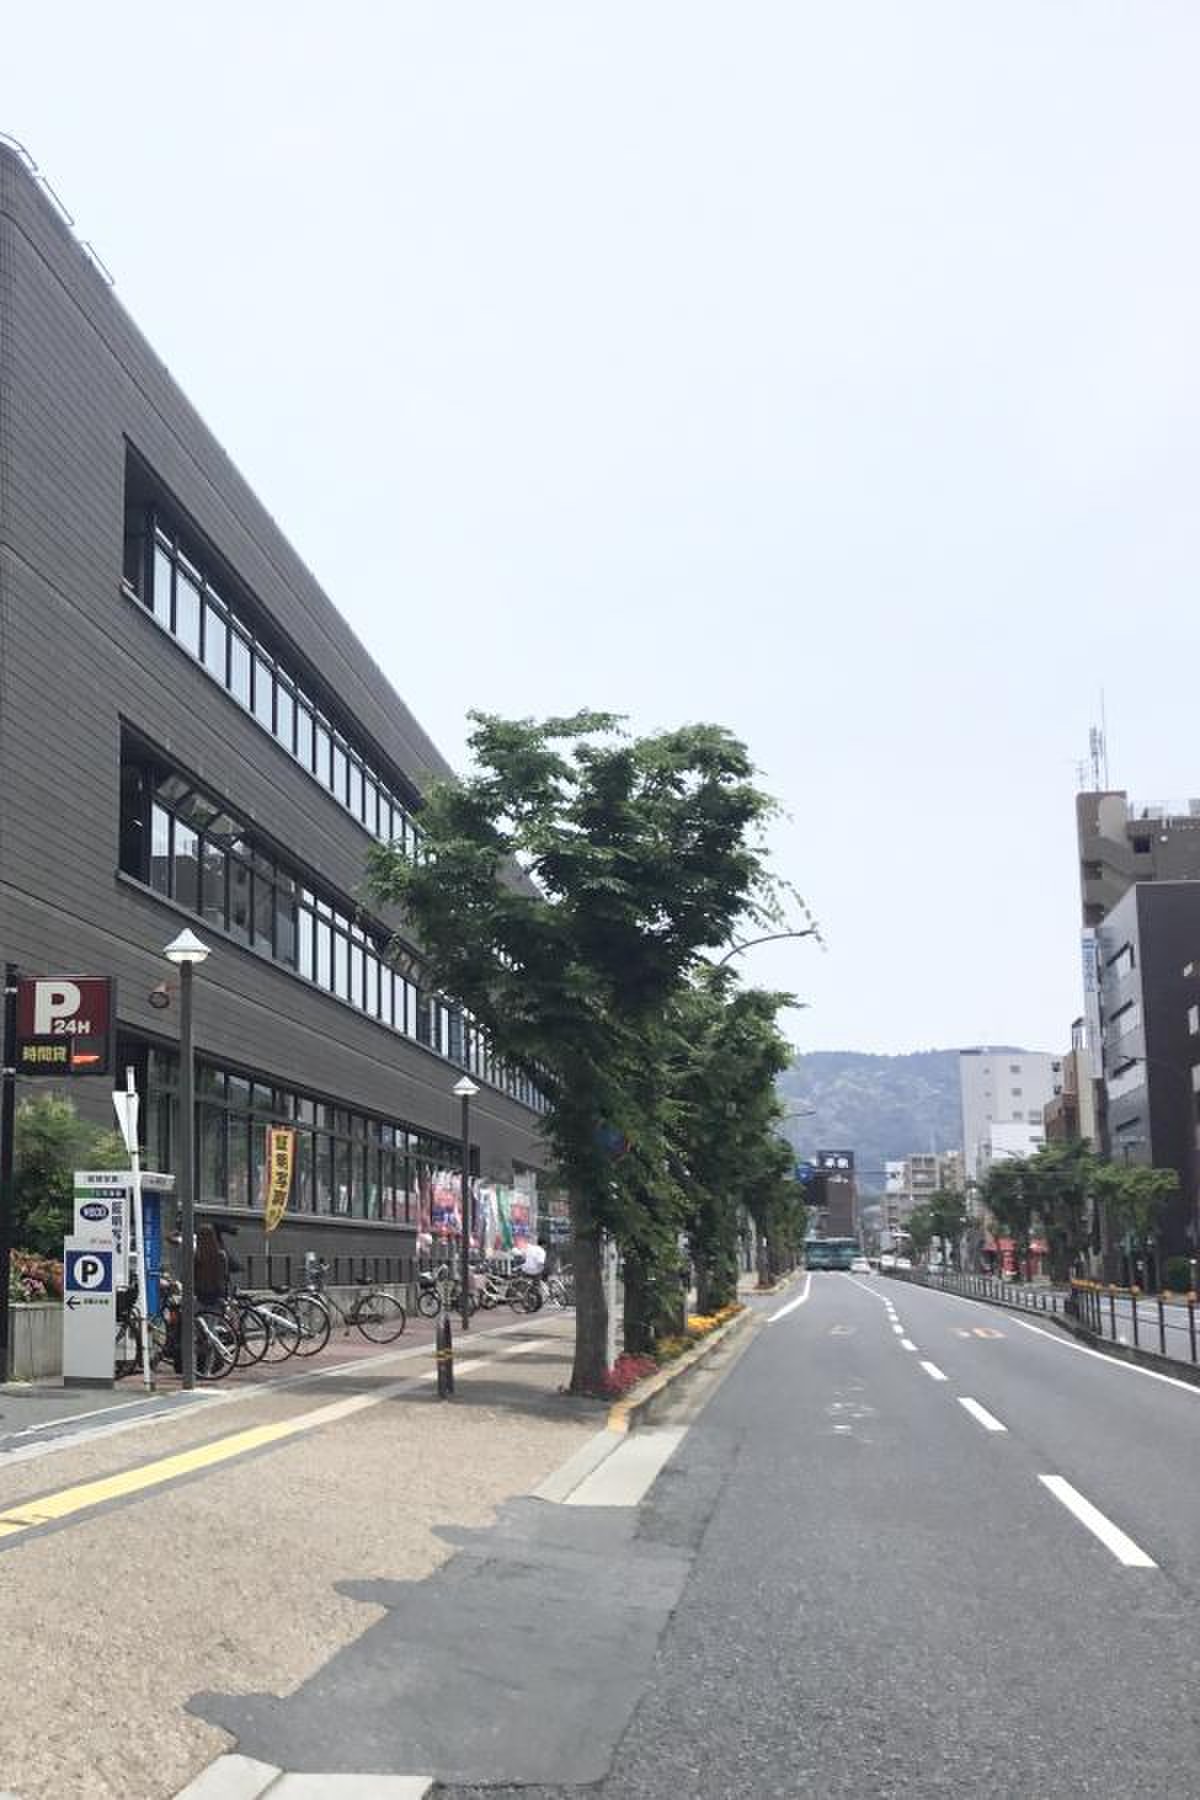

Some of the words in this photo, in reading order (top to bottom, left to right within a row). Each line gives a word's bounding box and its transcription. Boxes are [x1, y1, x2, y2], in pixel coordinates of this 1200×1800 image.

[34, 982, 81, 1035] P
[54, 1020, 91, 1035] 24H
[81, 1260, 98, 1283] P
